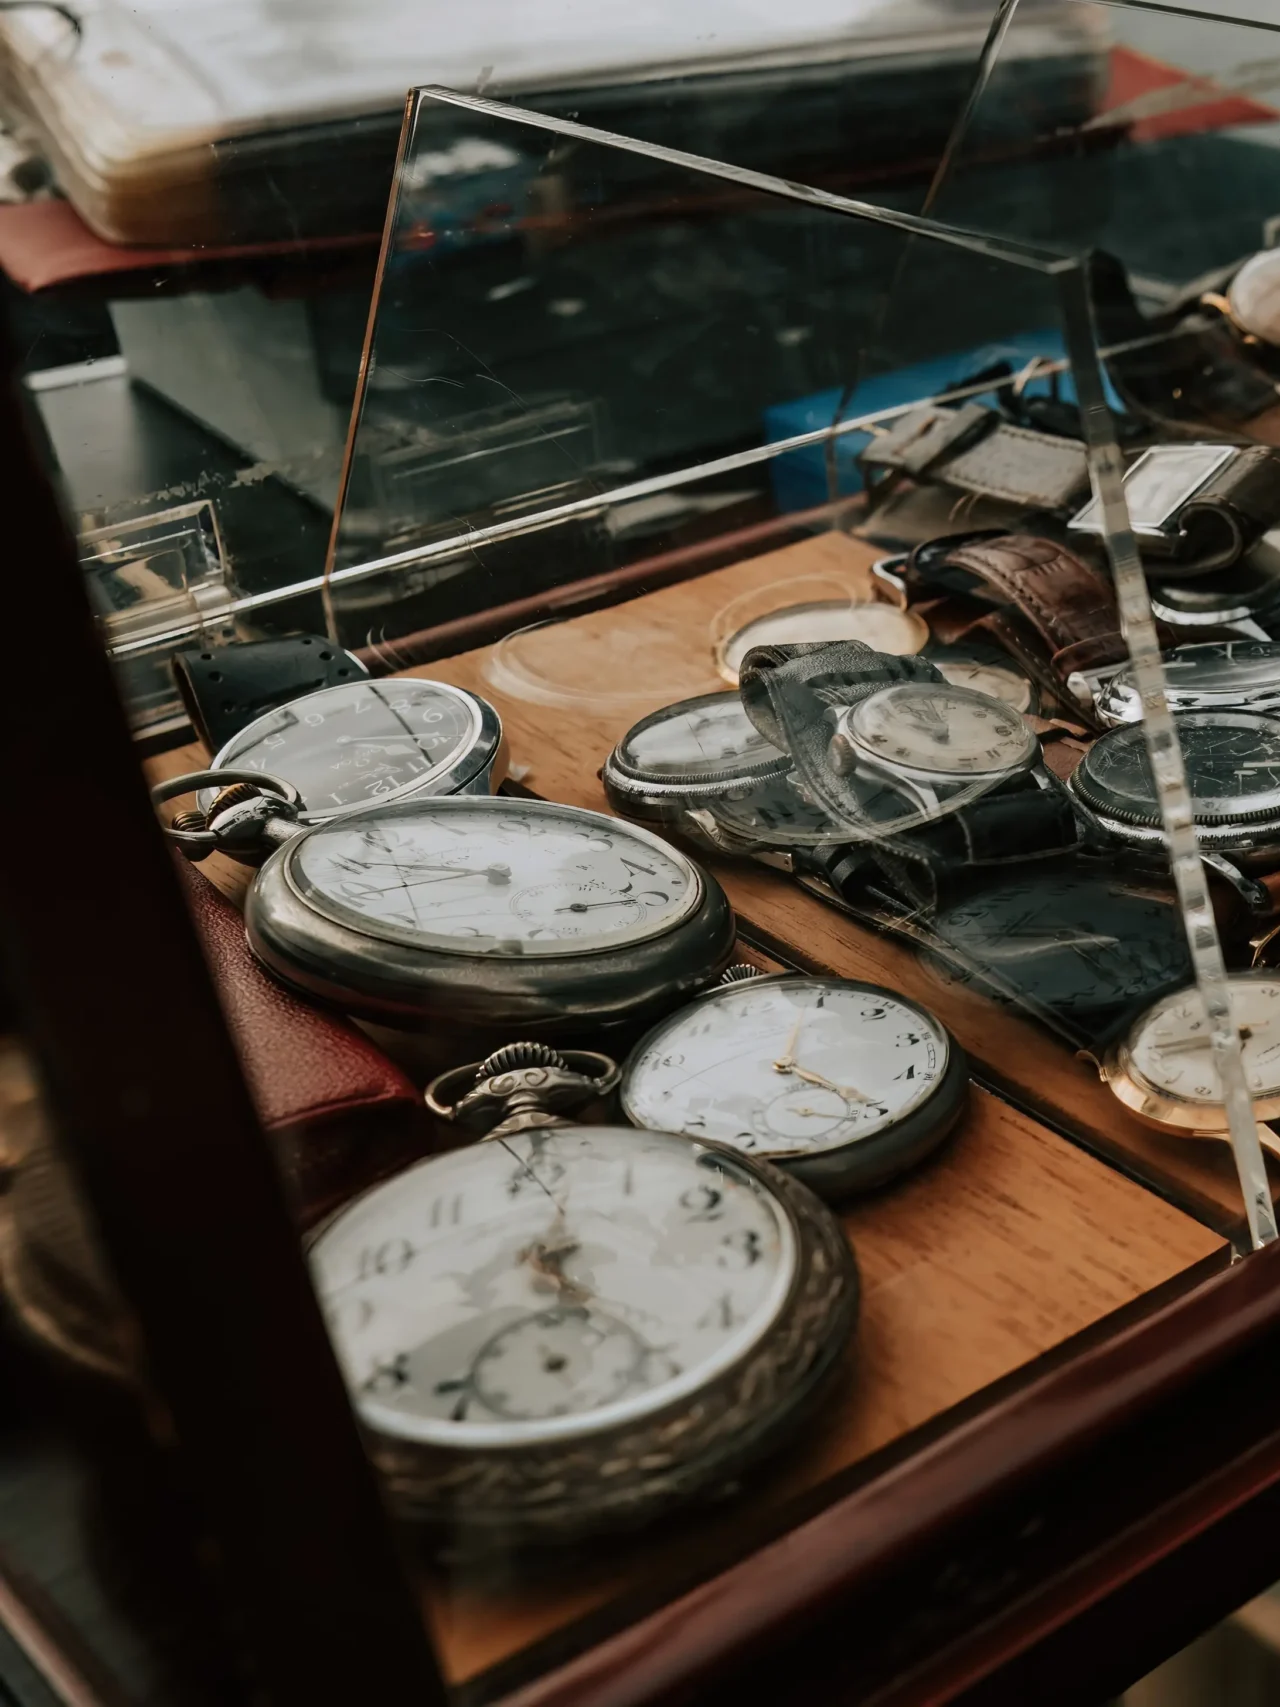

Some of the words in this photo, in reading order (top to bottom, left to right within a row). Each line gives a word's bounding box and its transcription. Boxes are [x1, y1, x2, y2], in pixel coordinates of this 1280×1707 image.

[304, 713, 326, 727] 6
[423, 707, 444, 723] 9
[262, 733, 286, 751] 5
[364, 775, 406, 796] 12
[620, 857, 657, 877] 4
[895, 1032, 920, 1047] 3
[430, 1193, 463, 1230] 11
[677, 1185, 724, 1222] 2
[356, 1236, 417, 1280] 10
[716, 1229, 763, 1268] 3
